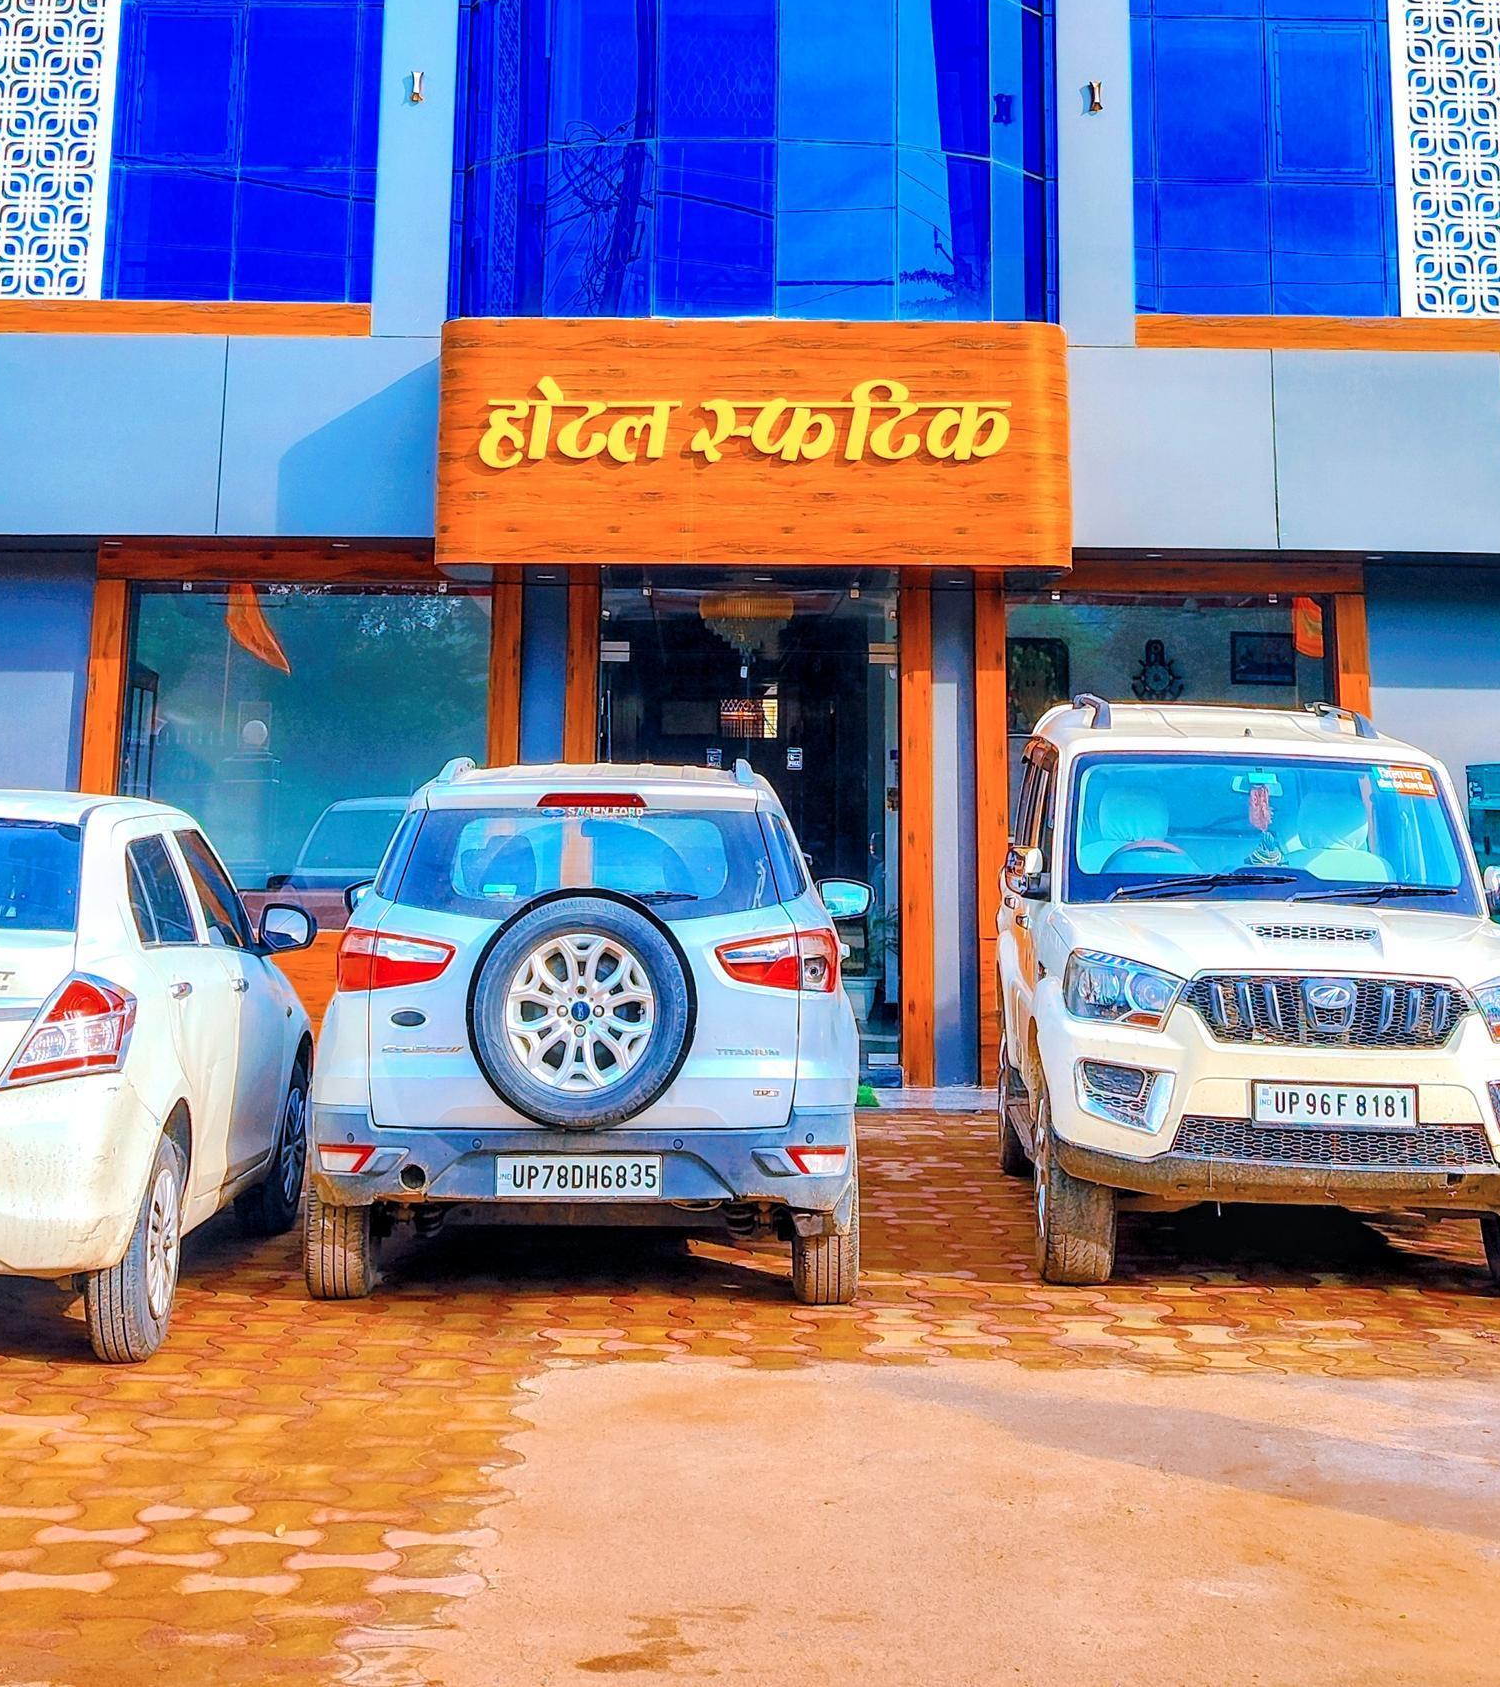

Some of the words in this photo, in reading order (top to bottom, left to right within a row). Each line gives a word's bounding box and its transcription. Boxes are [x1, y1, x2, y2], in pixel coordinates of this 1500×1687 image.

[478, 375, 683, 469] होटल
[690, 379, 1012, 463] स्फटिक
[512, 1163, 657, 1189] UP78DH6835
